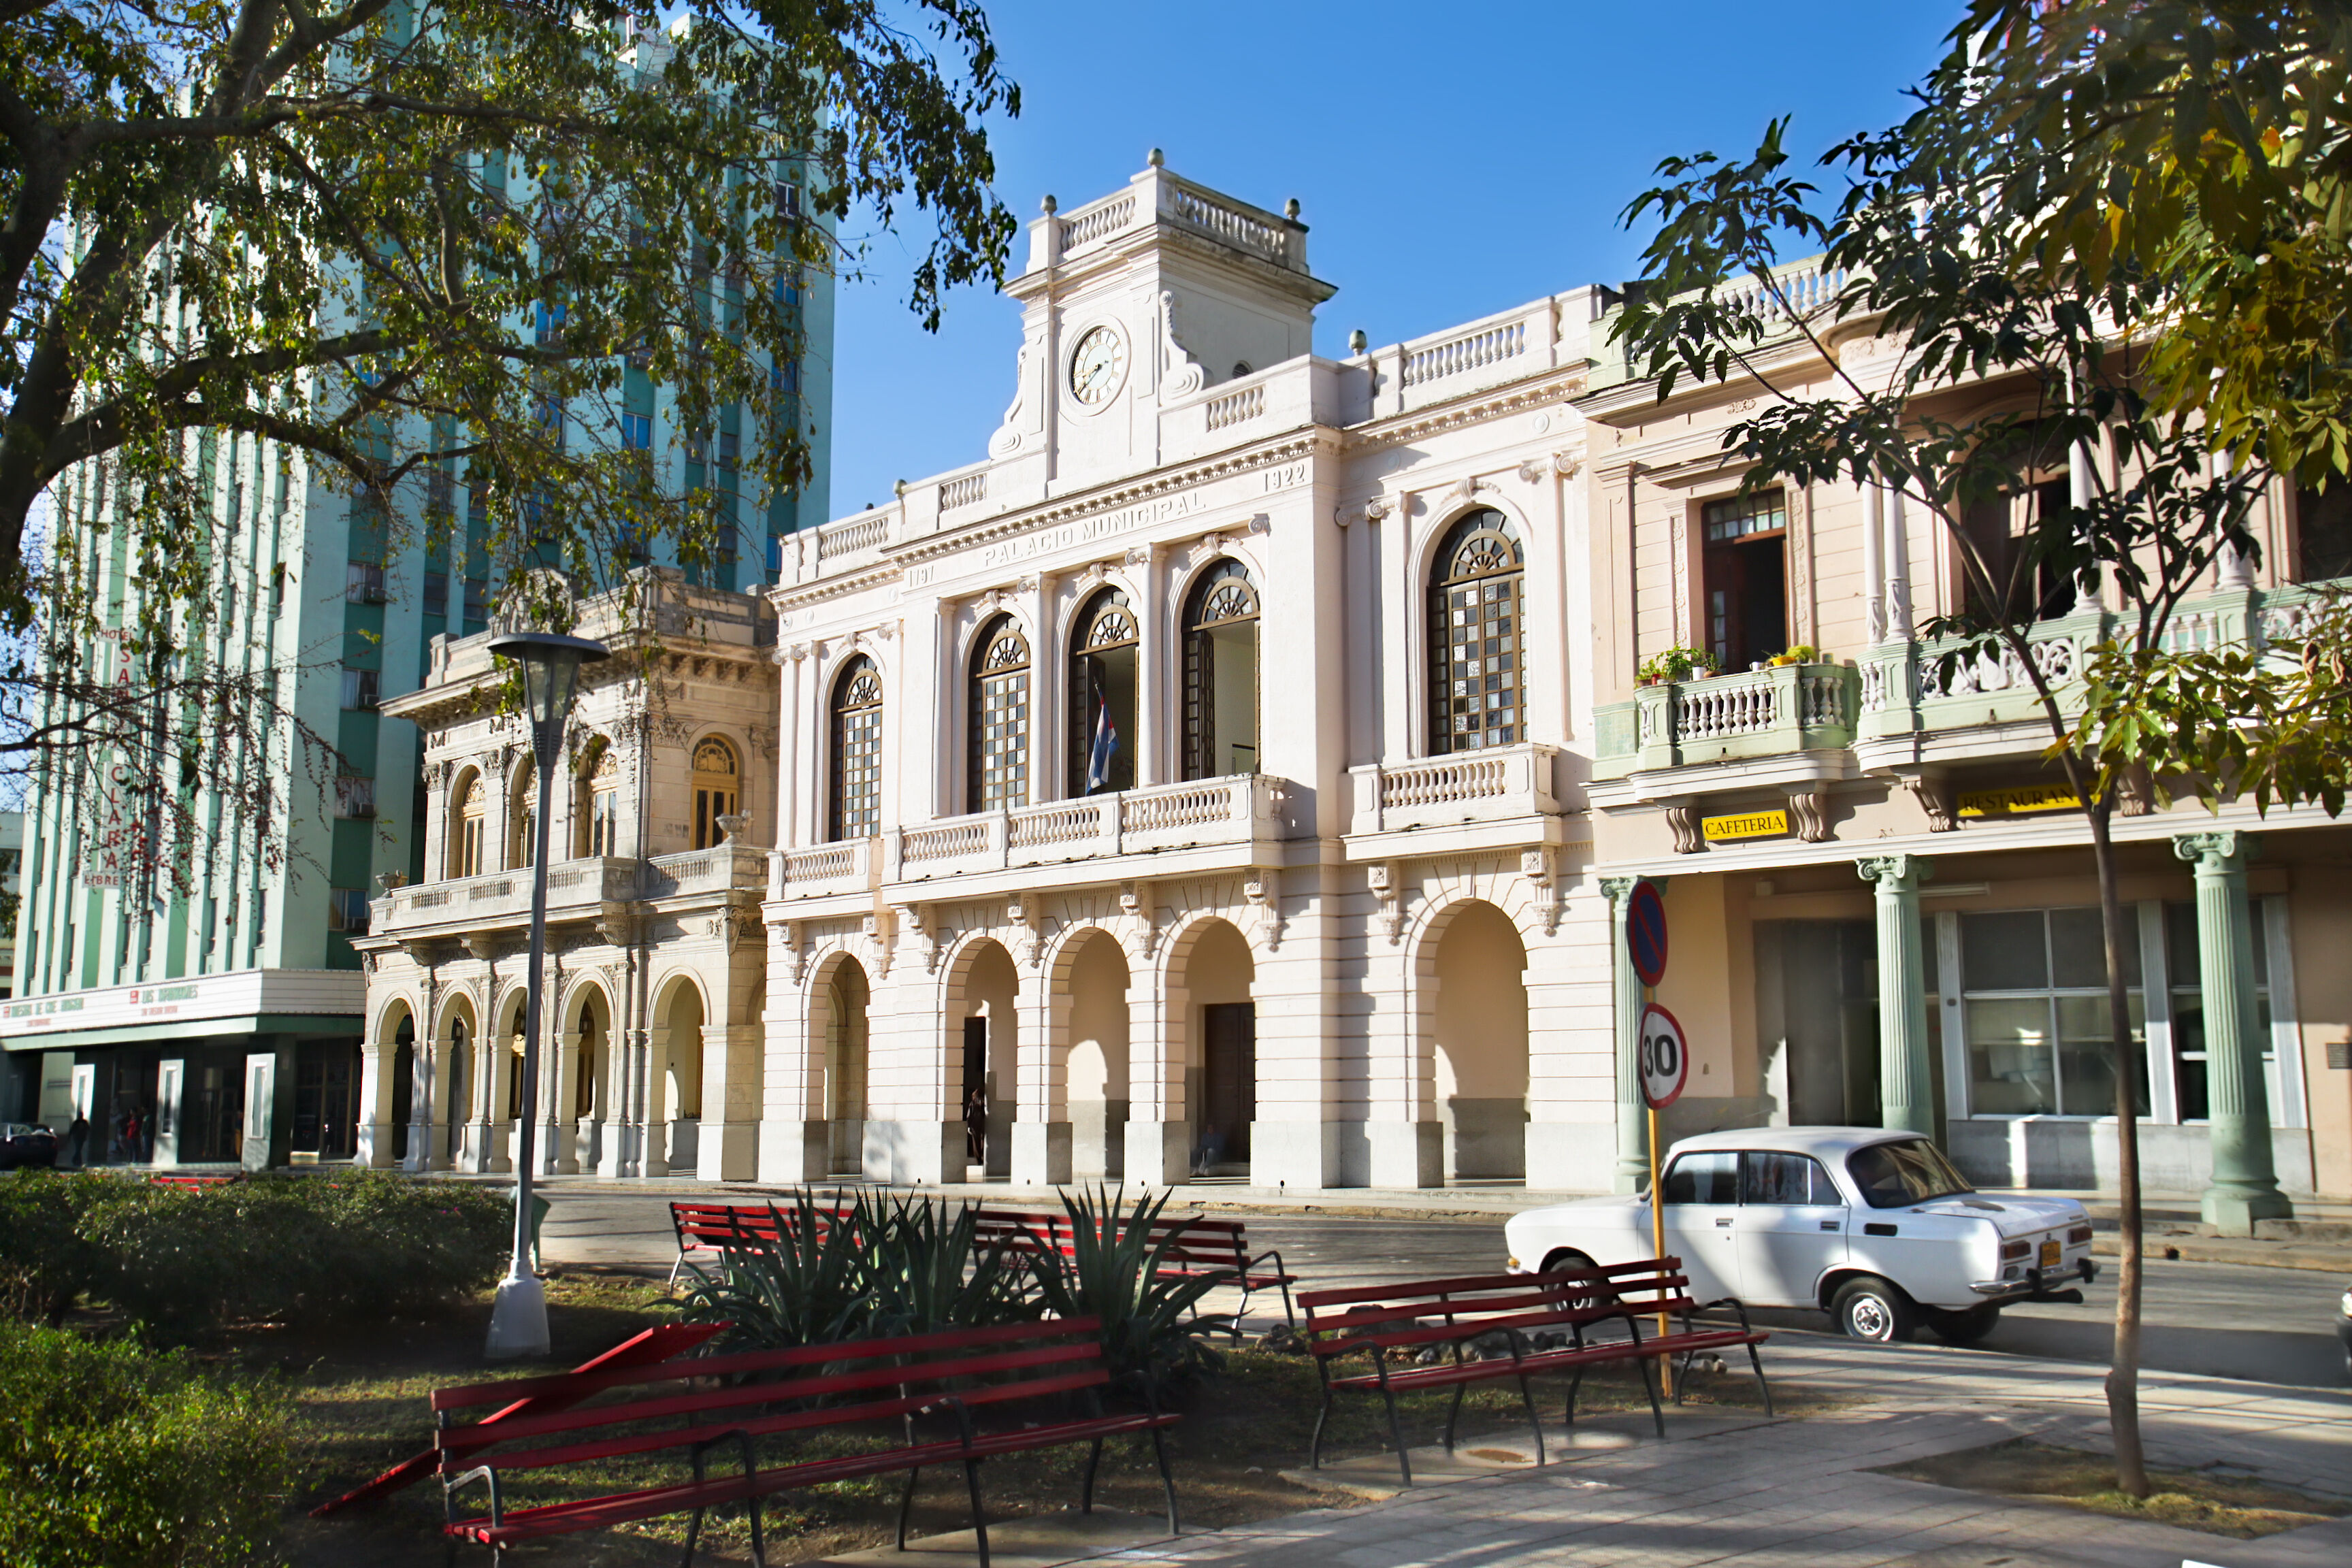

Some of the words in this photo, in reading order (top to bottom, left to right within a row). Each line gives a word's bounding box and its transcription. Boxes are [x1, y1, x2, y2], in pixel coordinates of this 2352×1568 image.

[909, 565, 936, 587] 1797
[985, 527, 1075, 567] PALACIO
[1083, 492, 1206, 540] MUNICIPAL
[1264, 463, 1305, 492] 1922
[101, 629, 132, 641] HOTEL
[105, 766, 123, 869] CLARA
[1705, 816, 1784, 836] CAFETERIA
[84, 874, 119, 885] LIBRE
[1644, 1034, 1677, 1077] 30
